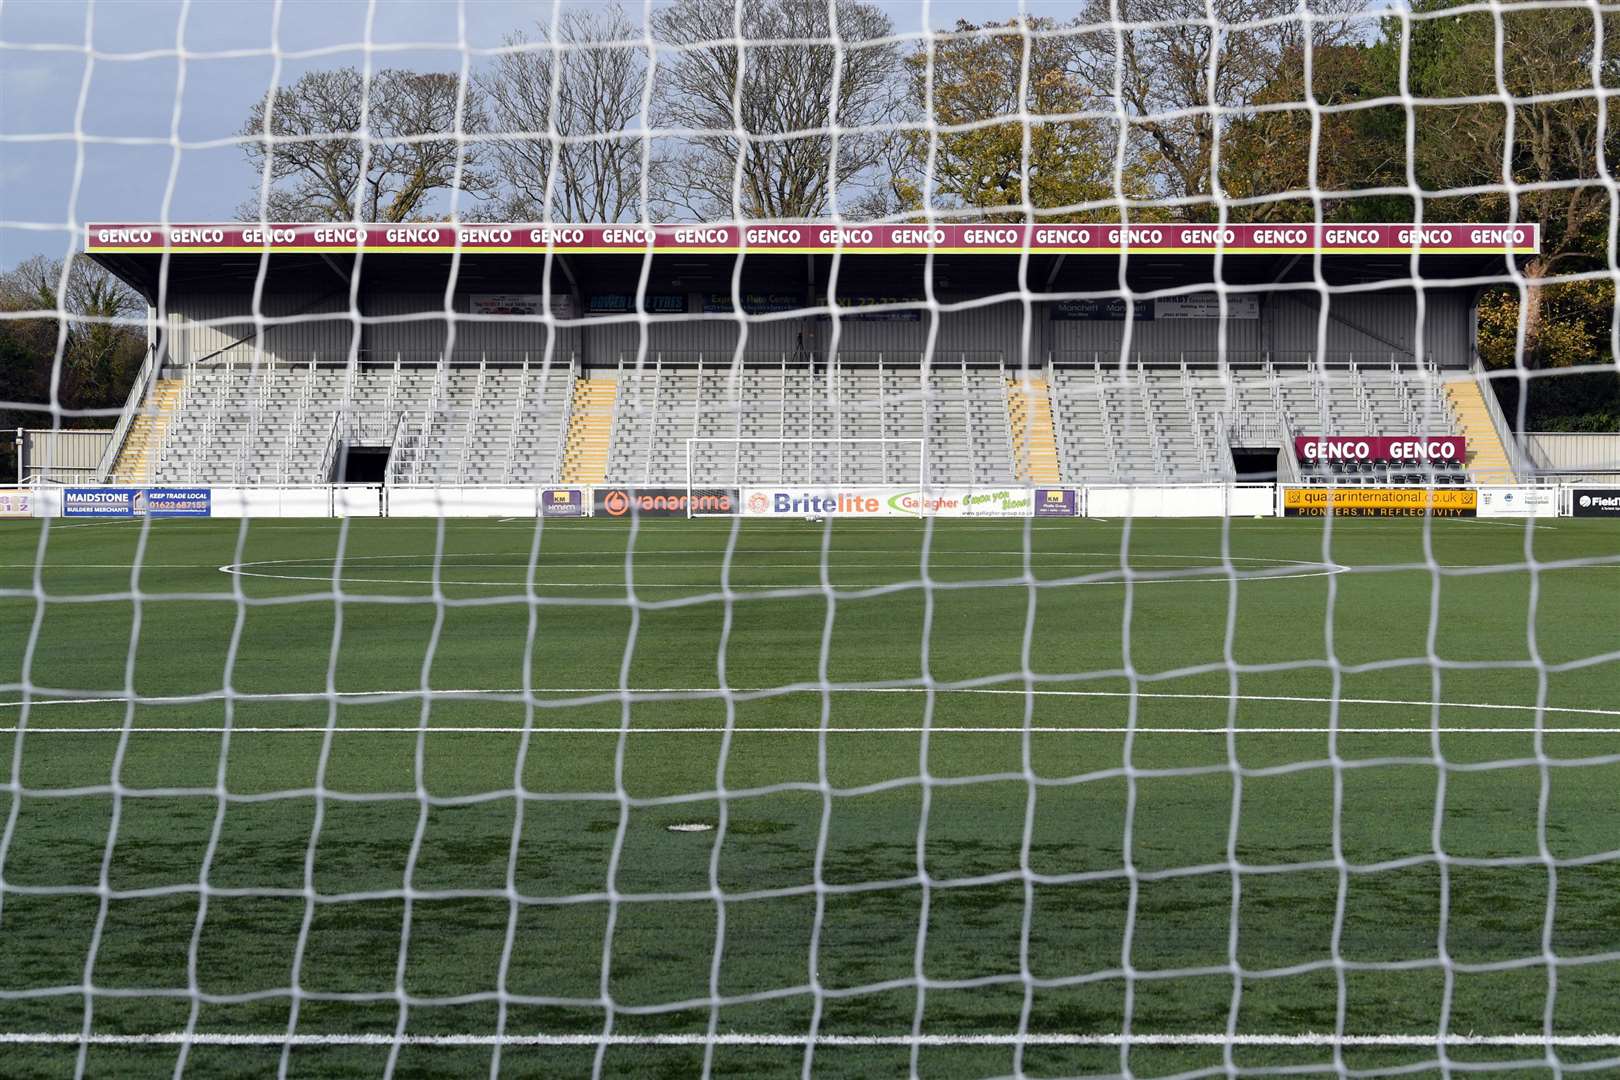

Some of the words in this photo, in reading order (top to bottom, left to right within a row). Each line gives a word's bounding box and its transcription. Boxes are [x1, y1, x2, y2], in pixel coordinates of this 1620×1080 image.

[98, 229, 152, 243] GENCO
[170, 229, 224, 243] GENCO
[242, 229, 296, 243] GENCO
[314, 229, 368, 243] GENCO
[386, 229, 440, 243] GENCO
[458, 229, 512, 243] GENCO
[530, 229, 584, 243] GENCO
[602, 229, 656, 243] GENCO
[674, 229, 728, 243] GENCO
[746, 229, 801, 243] GENCO
[819, 229, 873, 243] GENCO
[891, 229, 945, 243] GENCO
[963, 229, 1017, 243] GENCO
[1036, 229, 1090, 243] GENCO
[1108, 229, 1162, 243] GENCO
[1180, 229, 1235, 244] GENCO
[1253, 229, 1307, 244] GENCO
[1325, 229, 1379, 244] GENCO
[1397, 229, 1452, 244] GENCO
[1470, 229, 1525, 244] GENCO
[1304, 441, 1369, 459] GENCO
[1389, 441, 1455, 459] GENCO
[67, 493, 129, 502] MAIDSTONE
[774, 493, 879, 513] Britelite
[149, 501, 175, 509] 01622
[1363, 507, 1375, 516] IN
